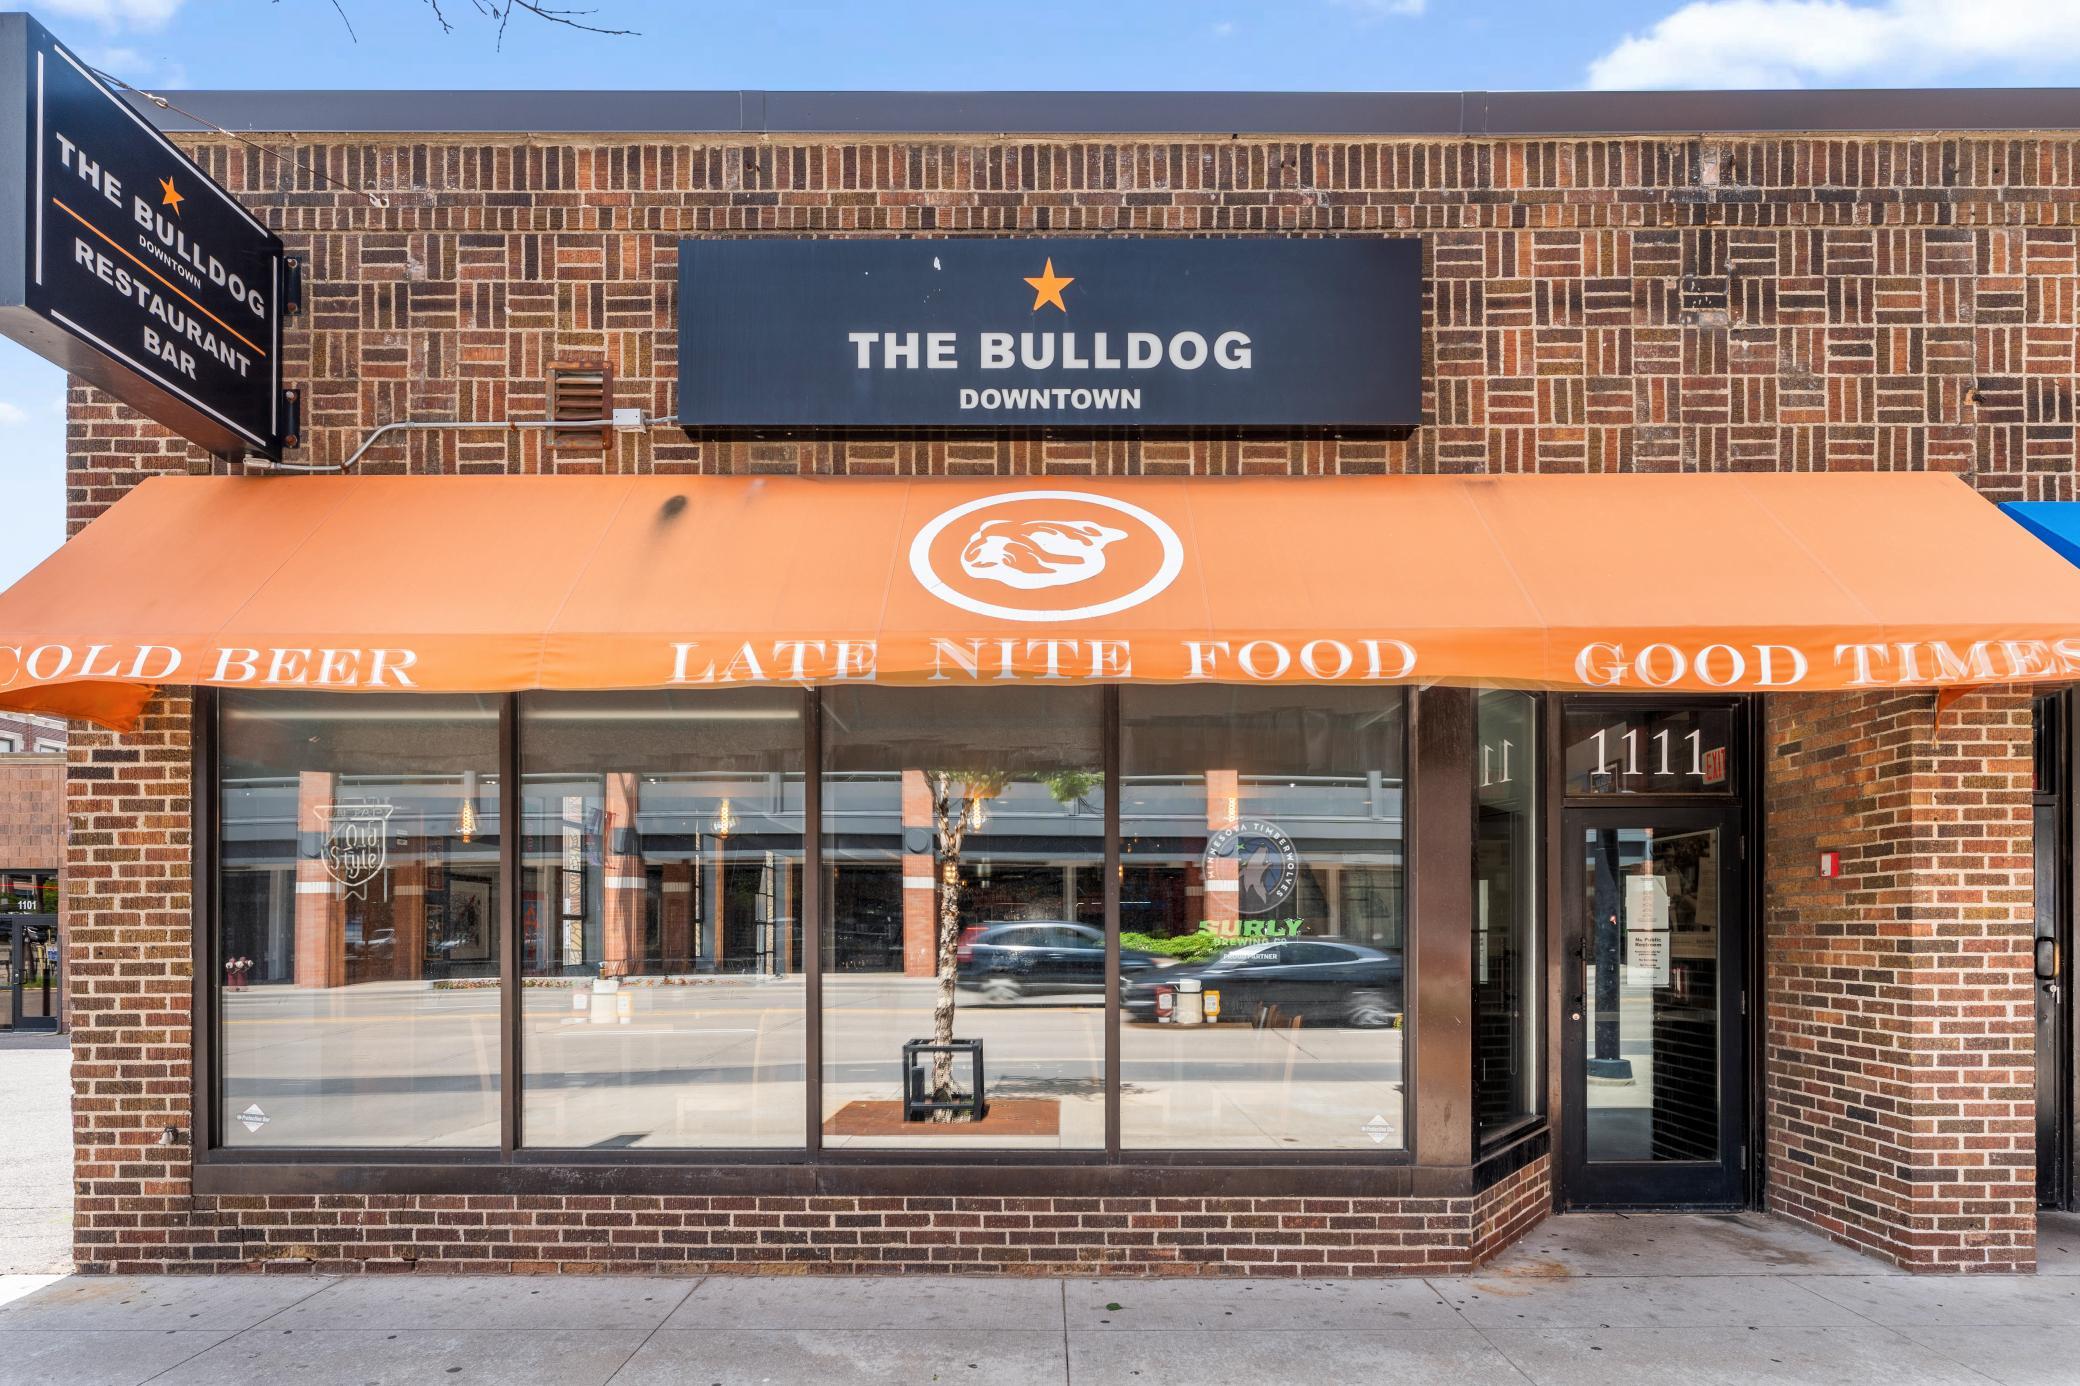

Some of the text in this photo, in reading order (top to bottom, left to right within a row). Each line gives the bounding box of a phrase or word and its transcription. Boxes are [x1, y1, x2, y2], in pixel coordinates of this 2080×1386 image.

[56, 132, 265, 319] THE BULLDOG
[139, 235, 201, 289] DOWNTOWN
[75, 237, 250, 378] RESTAURANT
[144, 325, 197, 381] BAR
[848, 331, 1252, 370] THE BULLDOG
[959, 388, 1141, 409] DOWNTOWN
[205, 647, 419, 687] BEER
[666, 637, 1418, 683] LATE NITE FOOD
[1574, 641, 1809, 687] GOOD
[1590, 728, 1706, 775] 1111
[1706, 748, 1726, 782] EXIT
[344, 824, 377, 849] Old
[331, 846, 377, 879] Style
[1206, 823, 1295, 897] MINNESOTA TIMBERWOLVES
[17, 900, 37, 910] 1101
[1199, 919, 1304, 937] SURLY
